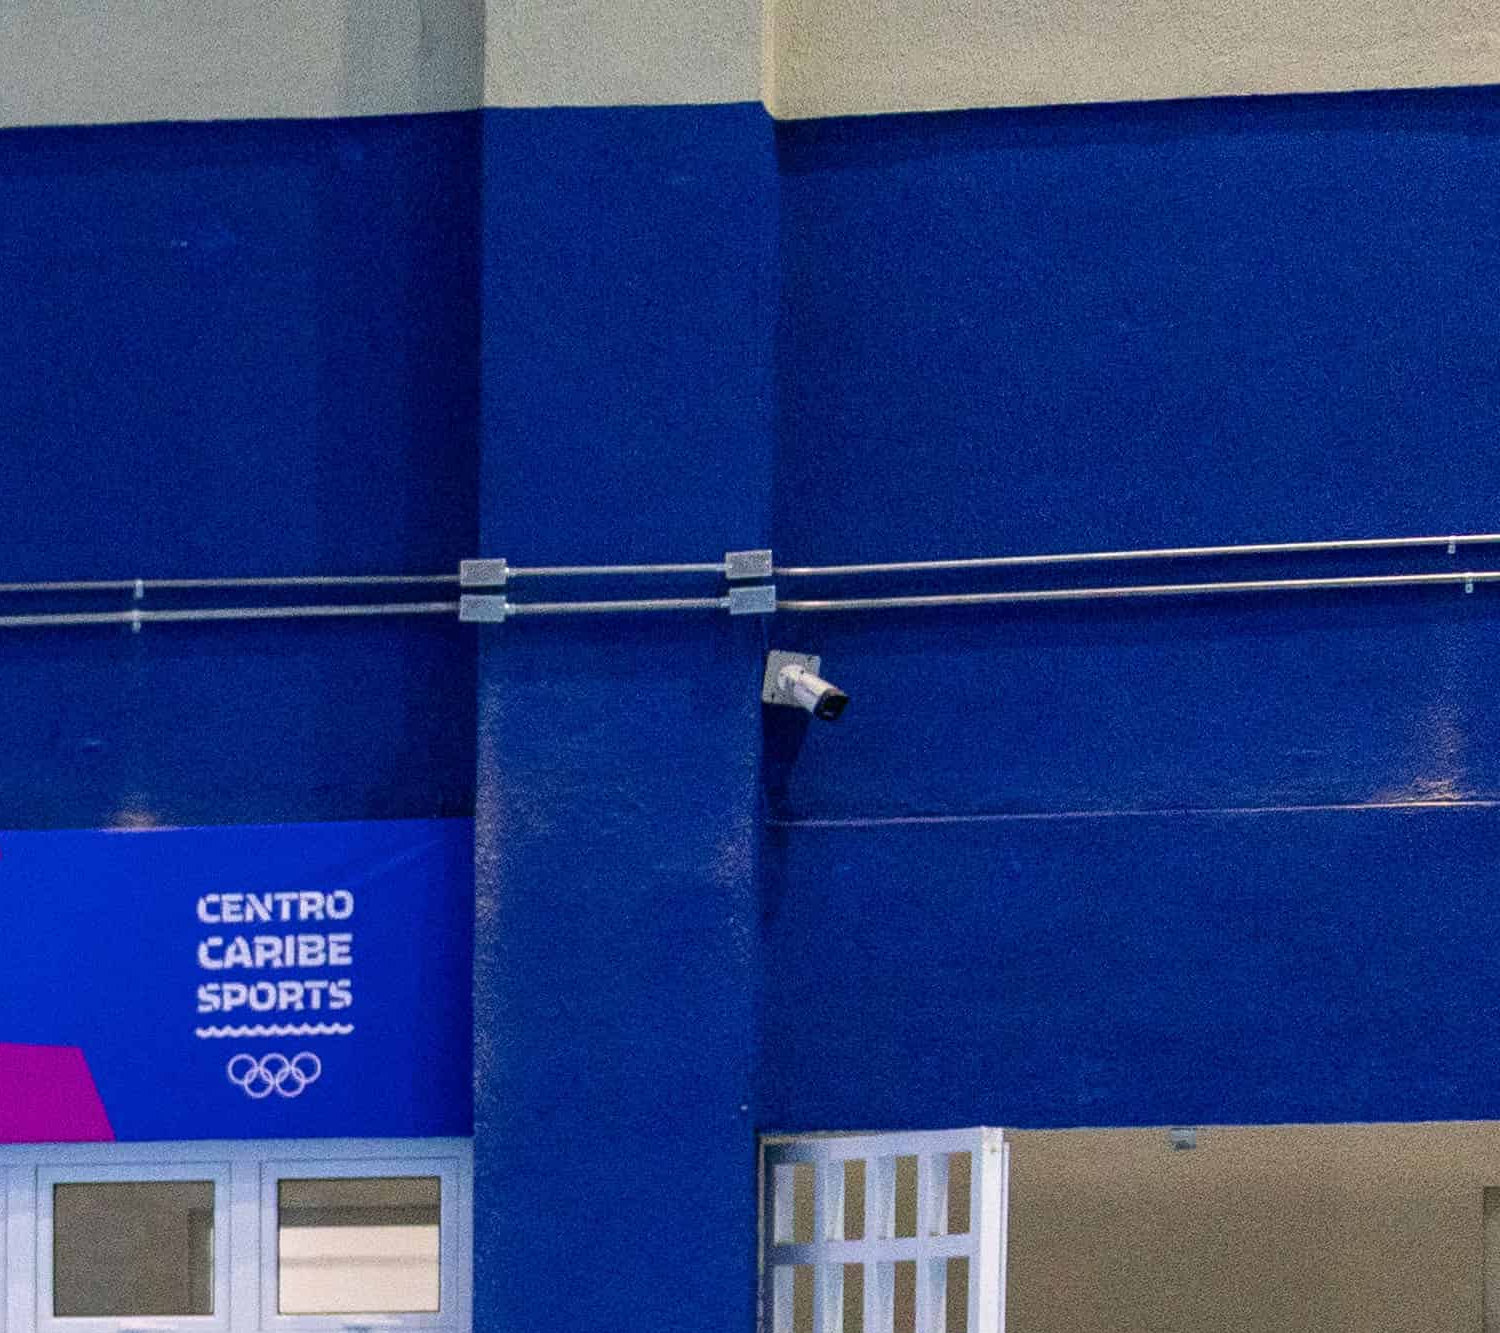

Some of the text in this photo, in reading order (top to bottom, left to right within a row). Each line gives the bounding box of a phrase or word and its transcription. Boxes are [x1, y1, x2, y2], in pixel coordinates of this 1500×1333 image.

[197, 890, 354, 923] CENTRO
[197, 933, 353, 970] CARIBE
[197, 979, 353, 1013] SPORTS
